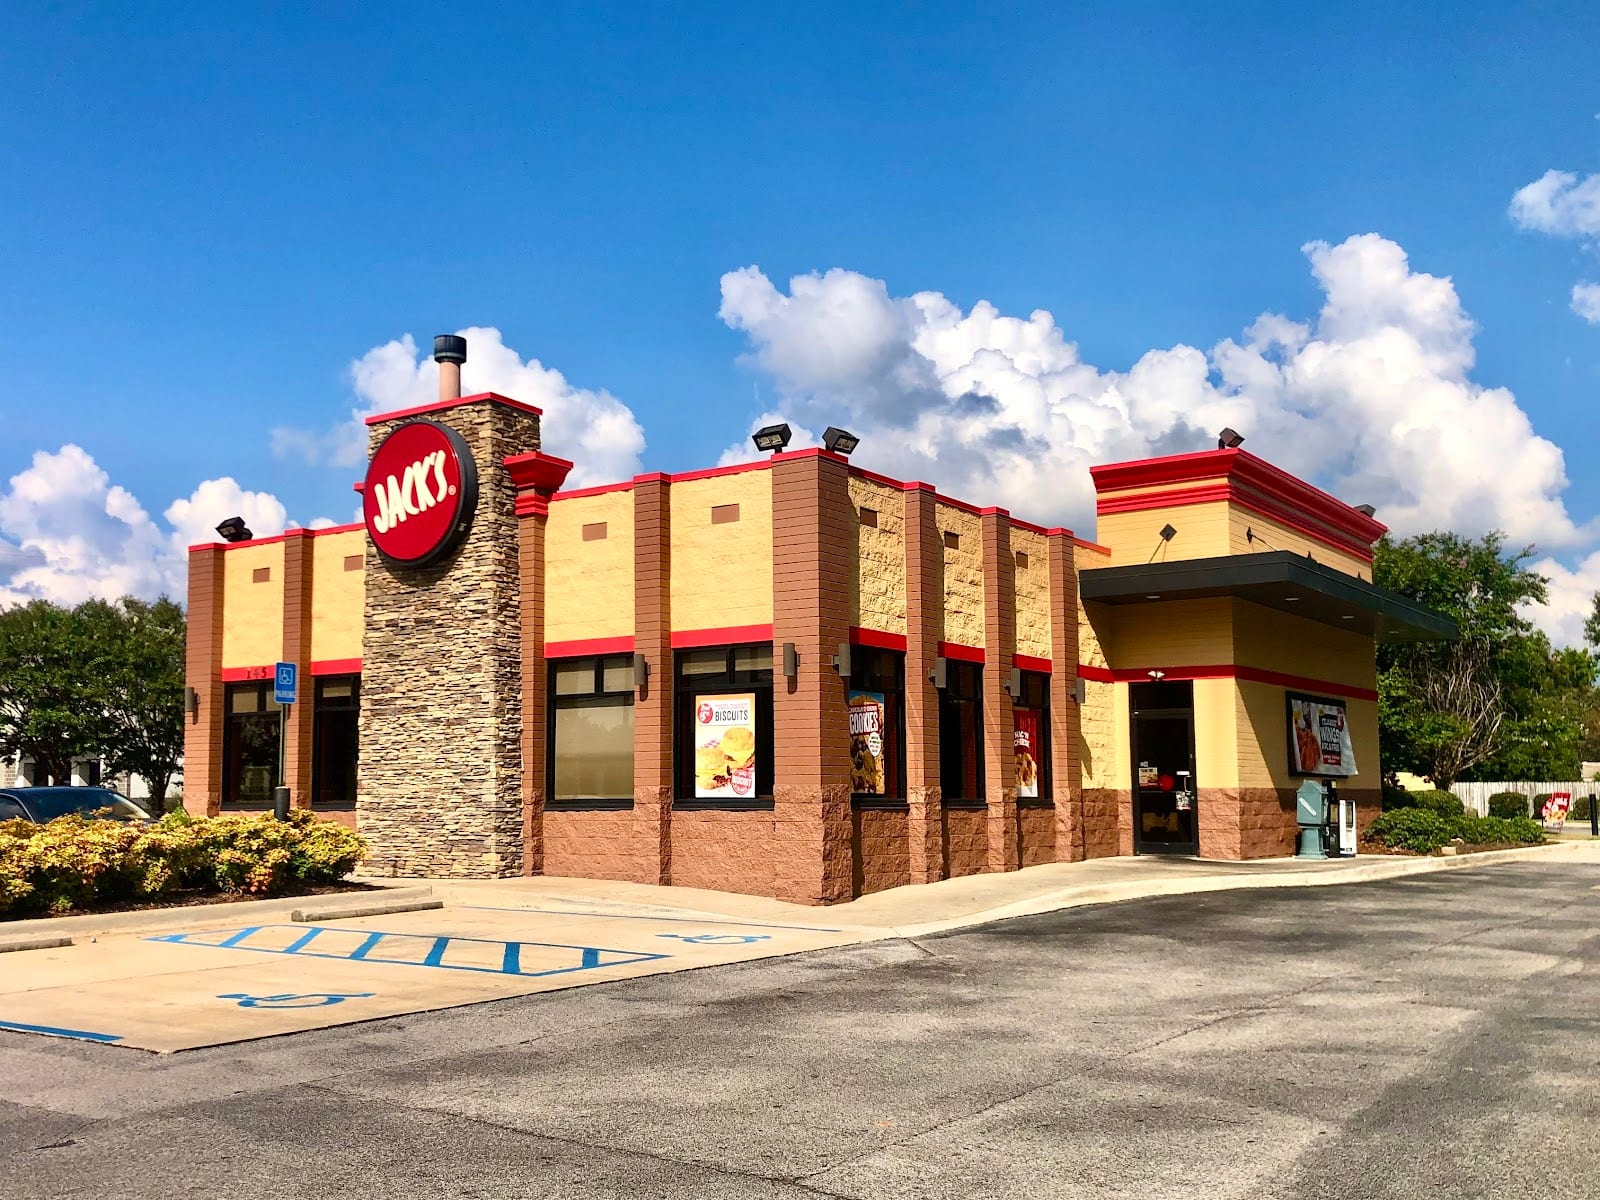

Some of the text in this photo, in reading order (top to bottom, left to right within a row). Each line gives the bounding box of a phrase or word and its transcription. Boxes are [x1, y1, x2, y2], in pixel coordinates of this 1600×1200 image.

[373, 450, 447, 534] JACK'S
[715, 709, 749, 721] BISCUITS
[849, 711, 879, 735] COOKIES
[1320, 726, 1341, 743] WINGS
